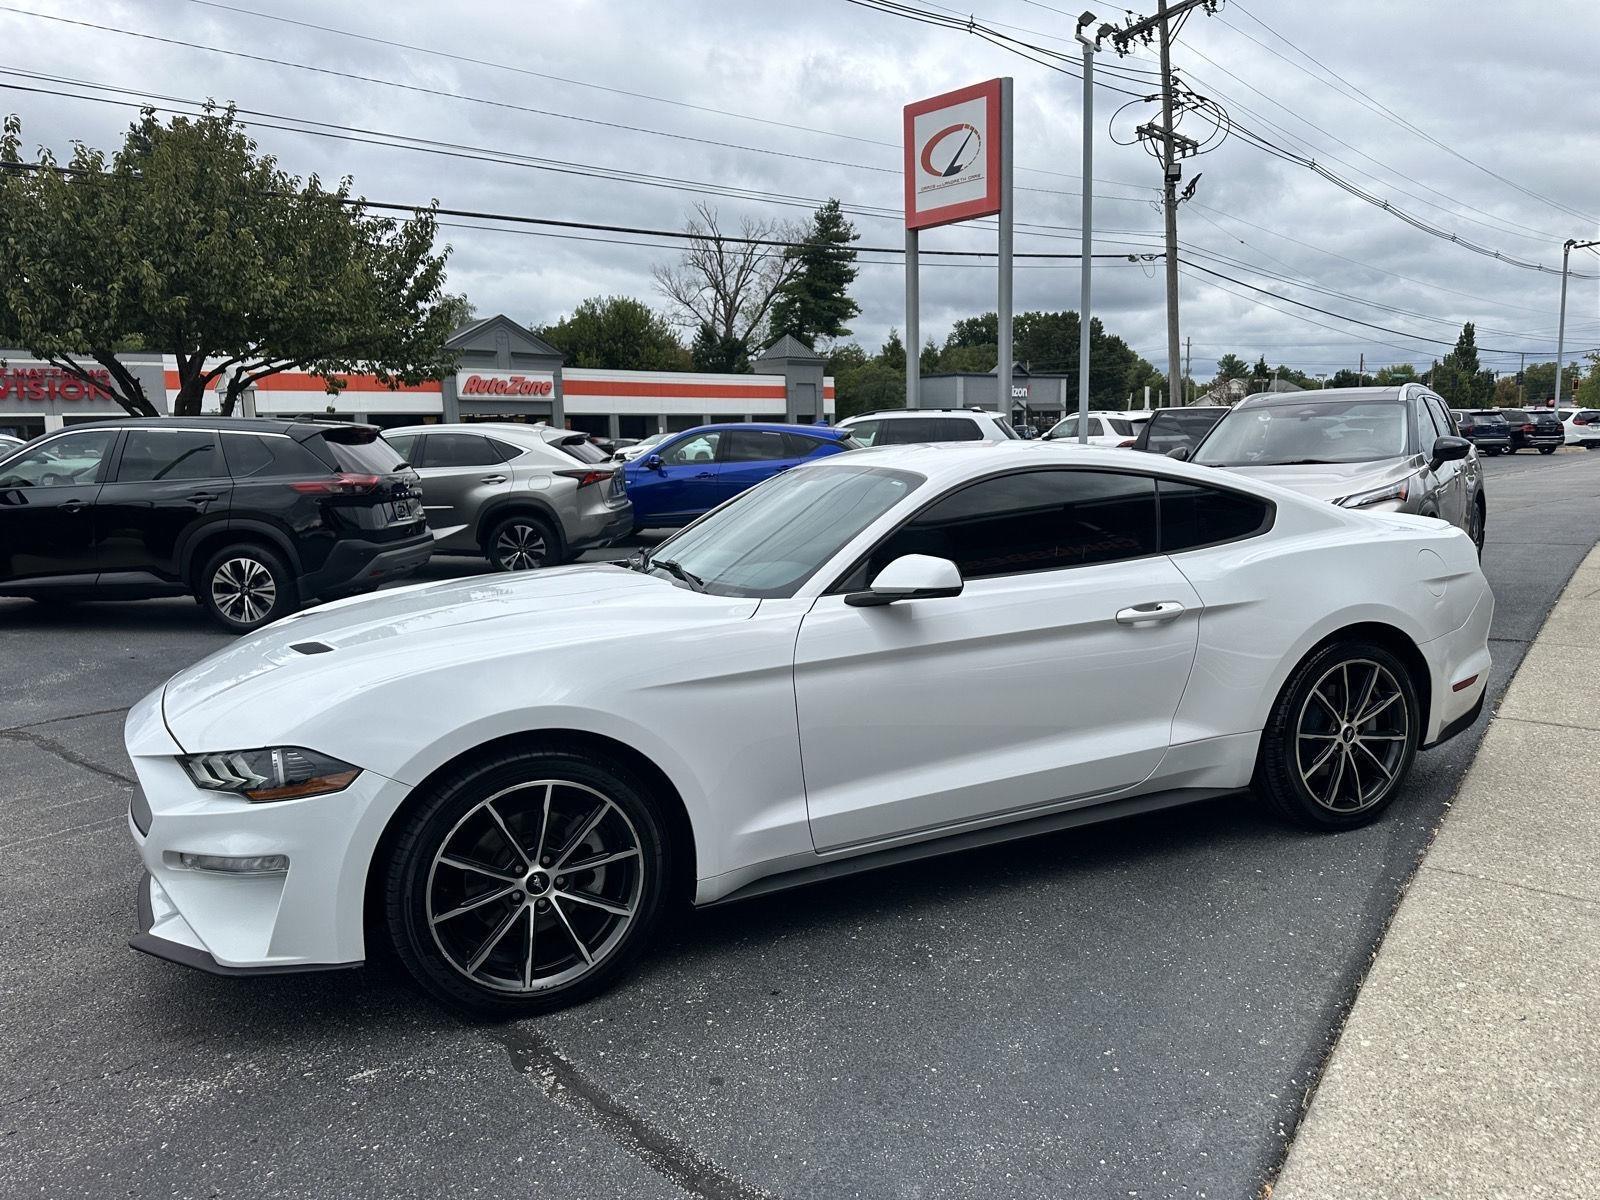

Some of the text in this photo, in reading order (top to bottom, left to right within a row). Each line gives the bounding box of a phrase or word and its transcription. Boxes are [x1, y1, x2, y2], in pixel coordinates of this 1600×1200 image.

[0, 379, 112, 401] VISION
[462, 375, 552, 395] AutoZone
[1011, 385, 1028, 398] izon
